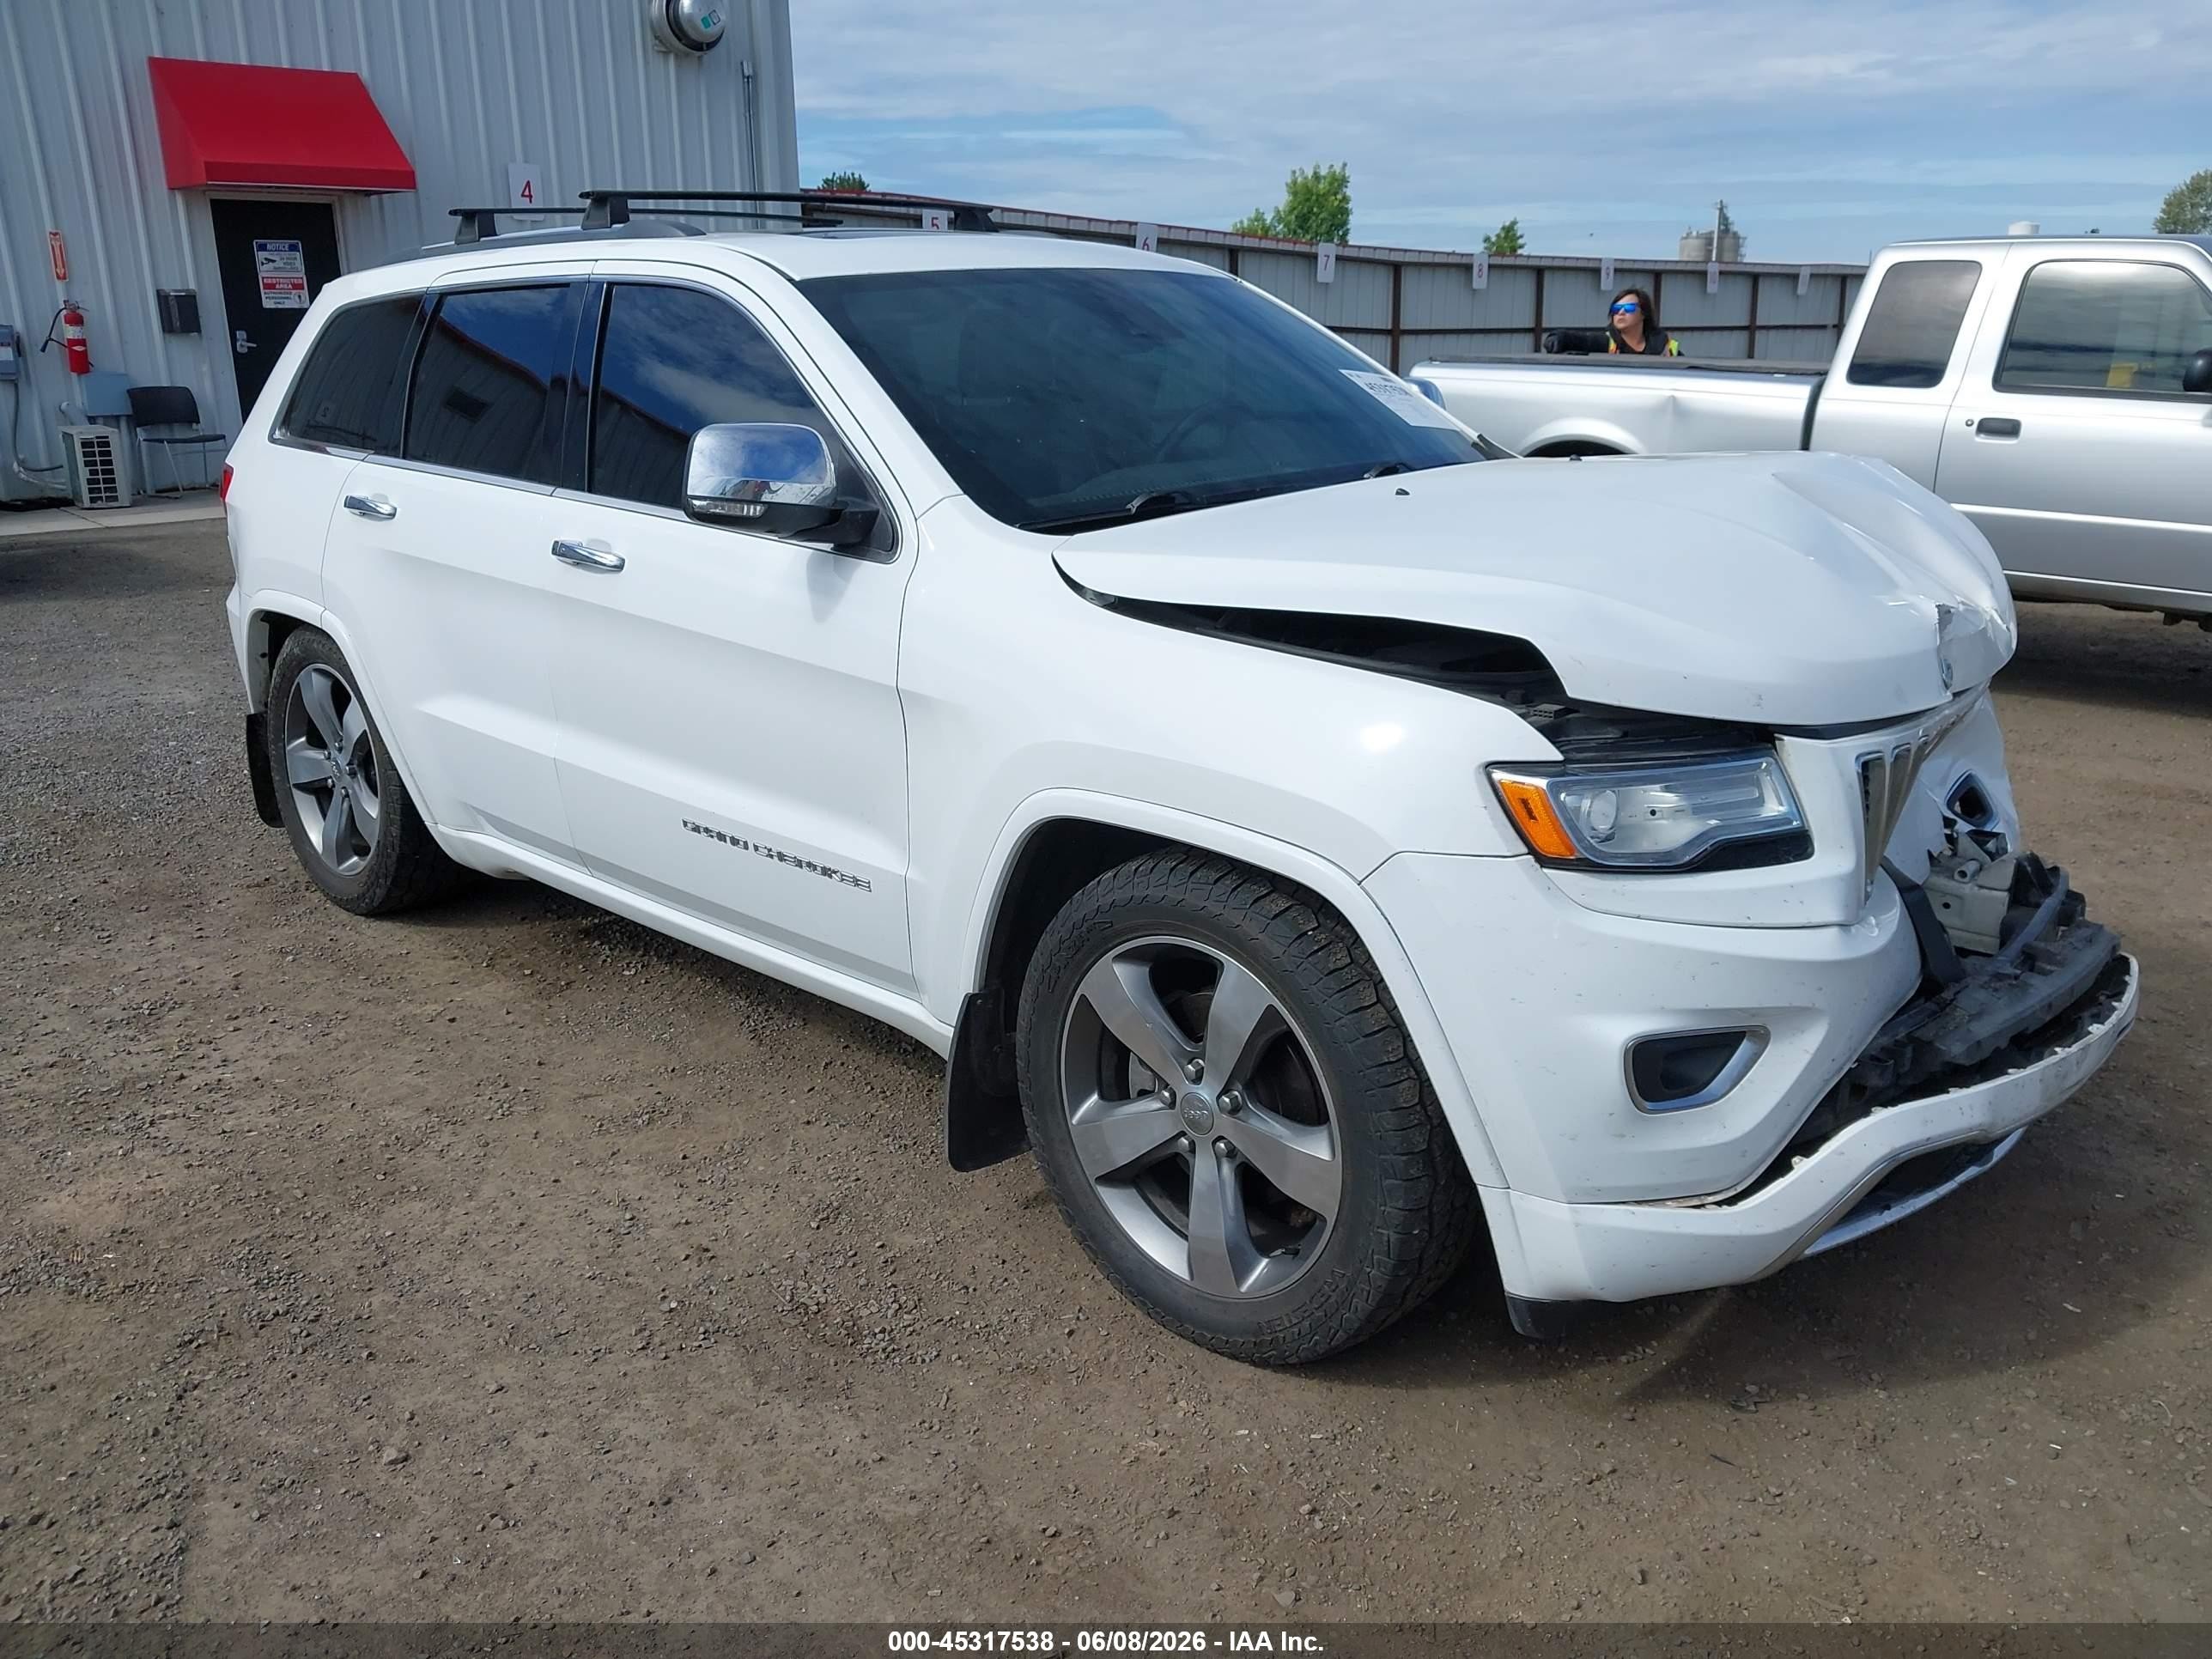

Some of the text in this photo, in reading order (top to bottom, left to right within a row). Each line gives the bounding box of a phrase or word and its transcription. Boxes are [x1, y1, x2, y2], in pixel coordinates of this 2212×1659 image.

[520, 179, 533, 204] 4
[1323, 254, 1331, 271] 7
[1477, 263, 1484, 278] 8
[681, 818, 872, 893] GRAND CHEROKEE
